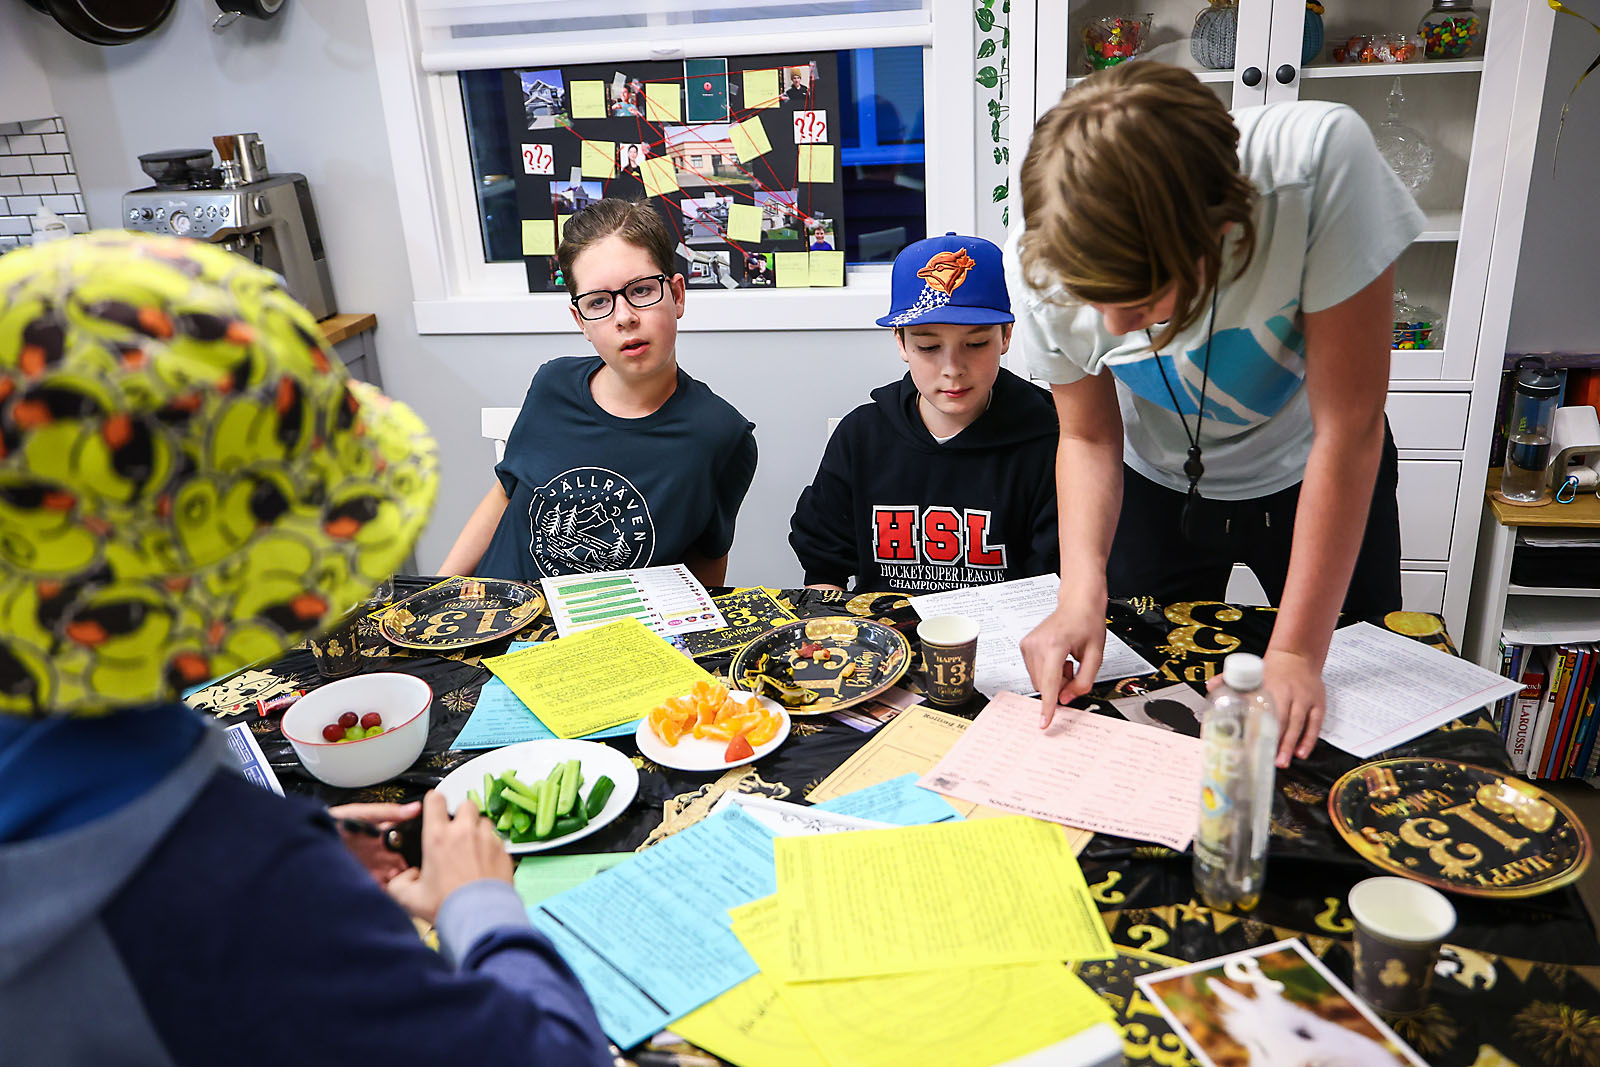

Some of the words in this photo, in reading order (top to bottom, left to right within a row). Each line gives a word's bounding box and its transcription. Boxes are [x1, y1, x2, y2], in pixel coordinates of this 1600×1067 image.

[794, 112, 825, 140] ???
[524, 144, 553, 174] ???
[538, 475, 647, 541] JÄLLRÄVEN
[872, 505, 1008, 569] HSL
[880, 564, 924, 579] HOCKEY
[925, 565, 959, 581] SUPER
[961, 567, 1005, 582] LEAGUE
[423, 607, 508, 637] 13
[1163, 601, 1242, 656] 3
[933, 662, 967, 686] 13
[936, 655, 962, 663] HAPPY
[1512, 703, 1532, 756] LAROUSSE
[1398, 798, 1530, 879] 13
[1472, 853, 1554, 888] HAPPY
